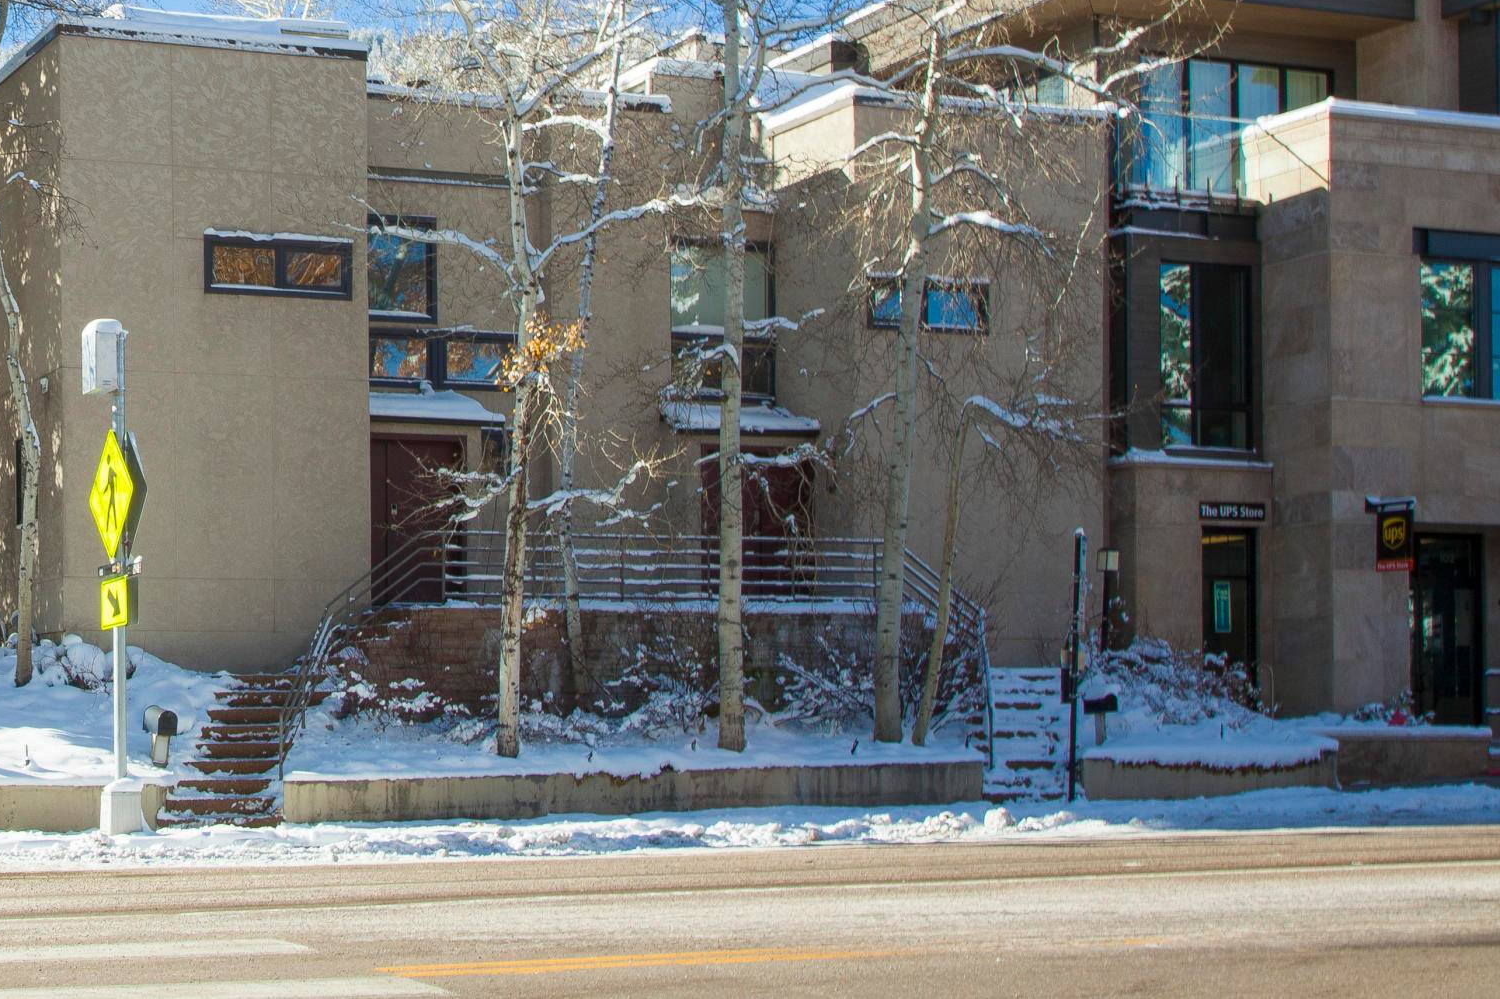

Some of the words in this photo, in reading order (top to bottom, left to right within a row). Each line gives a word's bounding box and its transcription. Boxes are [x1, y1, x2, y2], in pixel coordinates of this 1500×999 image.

[1201, 504, 1217, 517] The
[1220, 505, 1238, 517] UPS
[1240, 506, 1264, 518] Store
[1384, 527, 1404, 544] ups
